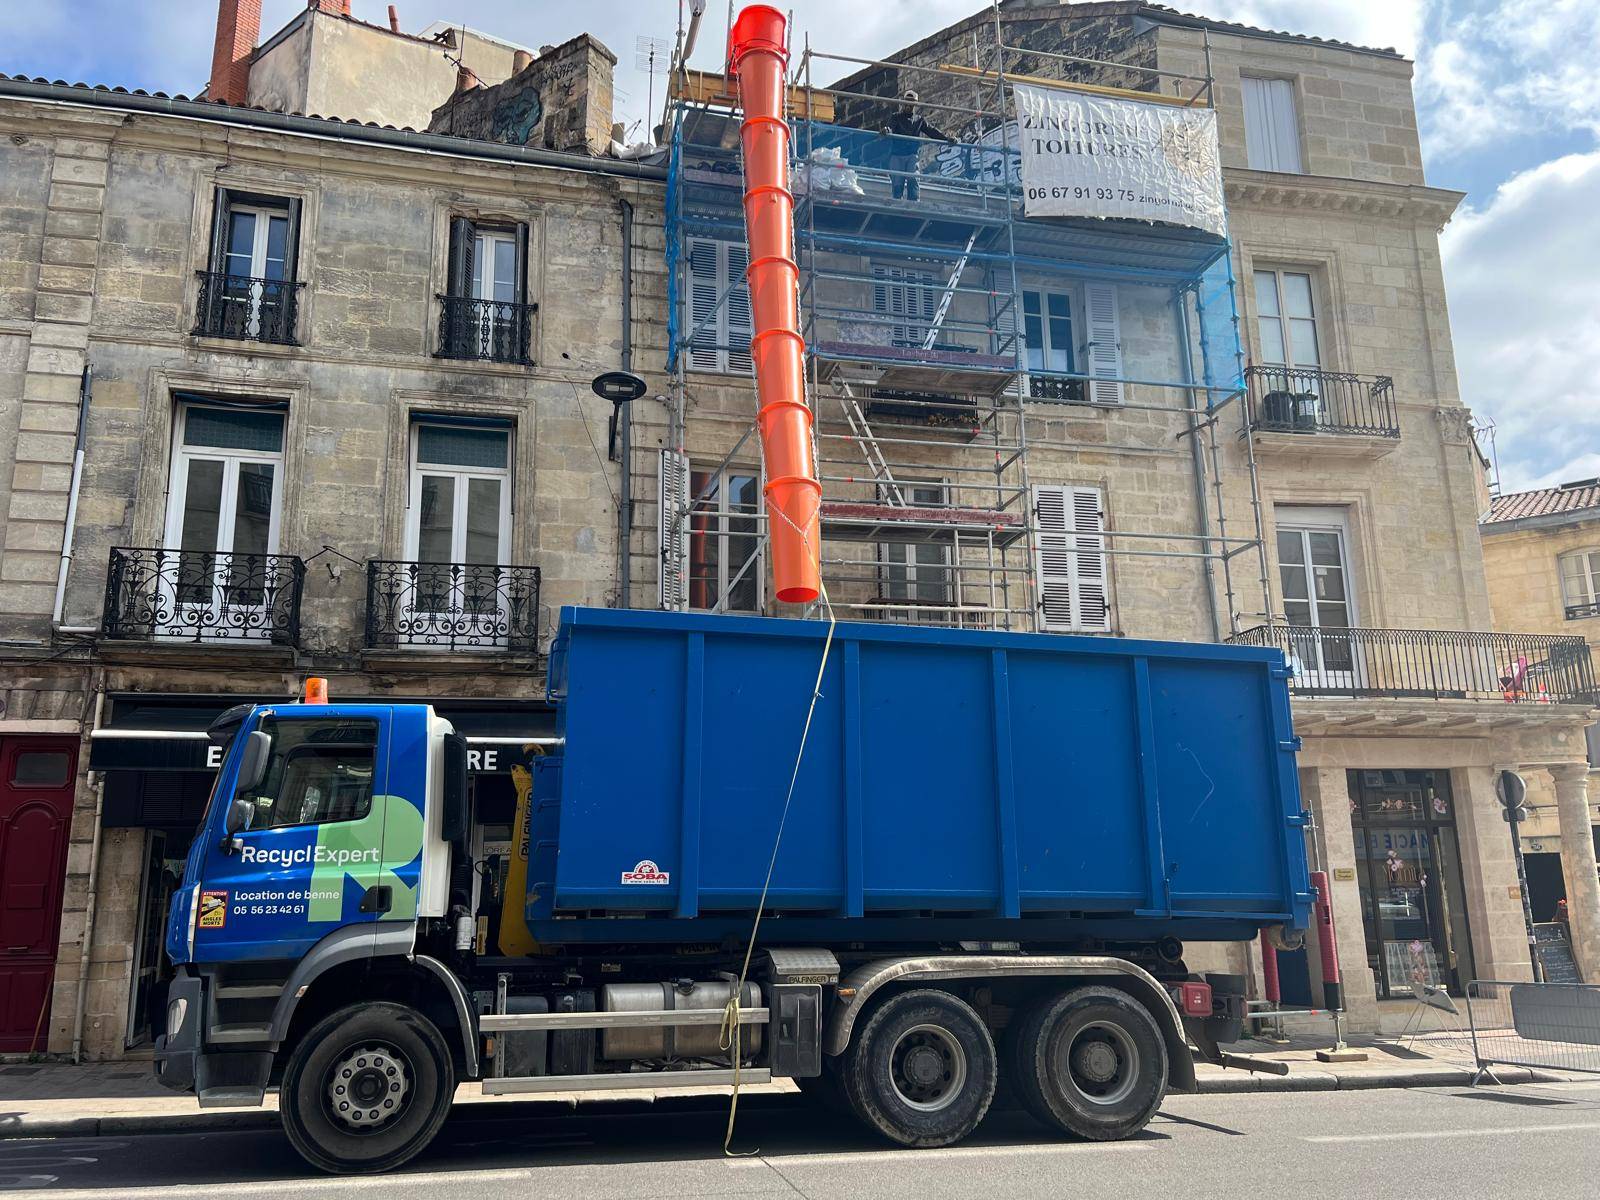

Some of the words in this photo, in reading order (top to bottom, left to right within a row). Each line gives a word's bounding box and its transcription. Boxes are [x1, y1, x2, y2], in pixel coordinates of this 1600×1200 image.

[1031, 138, 1144, 159] TOITURES
[1028, 187, 1047, 200] 06
[1051, 186, 1069, 199] 67
[1074, 186, 1090, 199] 91
[1096, 187, 1114, 200] 93
[1117, 189, 1135, 202] 75
[234, 890, 285, 901] Location
[287, 890, 302, 900] de
[304, 890, 340, 900] benne
[233, 906, 247, 915] 05
[251, 906, 263, 915] 56
[265, 906, 278, 915] 23
[279, 906, 292, 915] 42
[294, 905, 305, 914] 61
